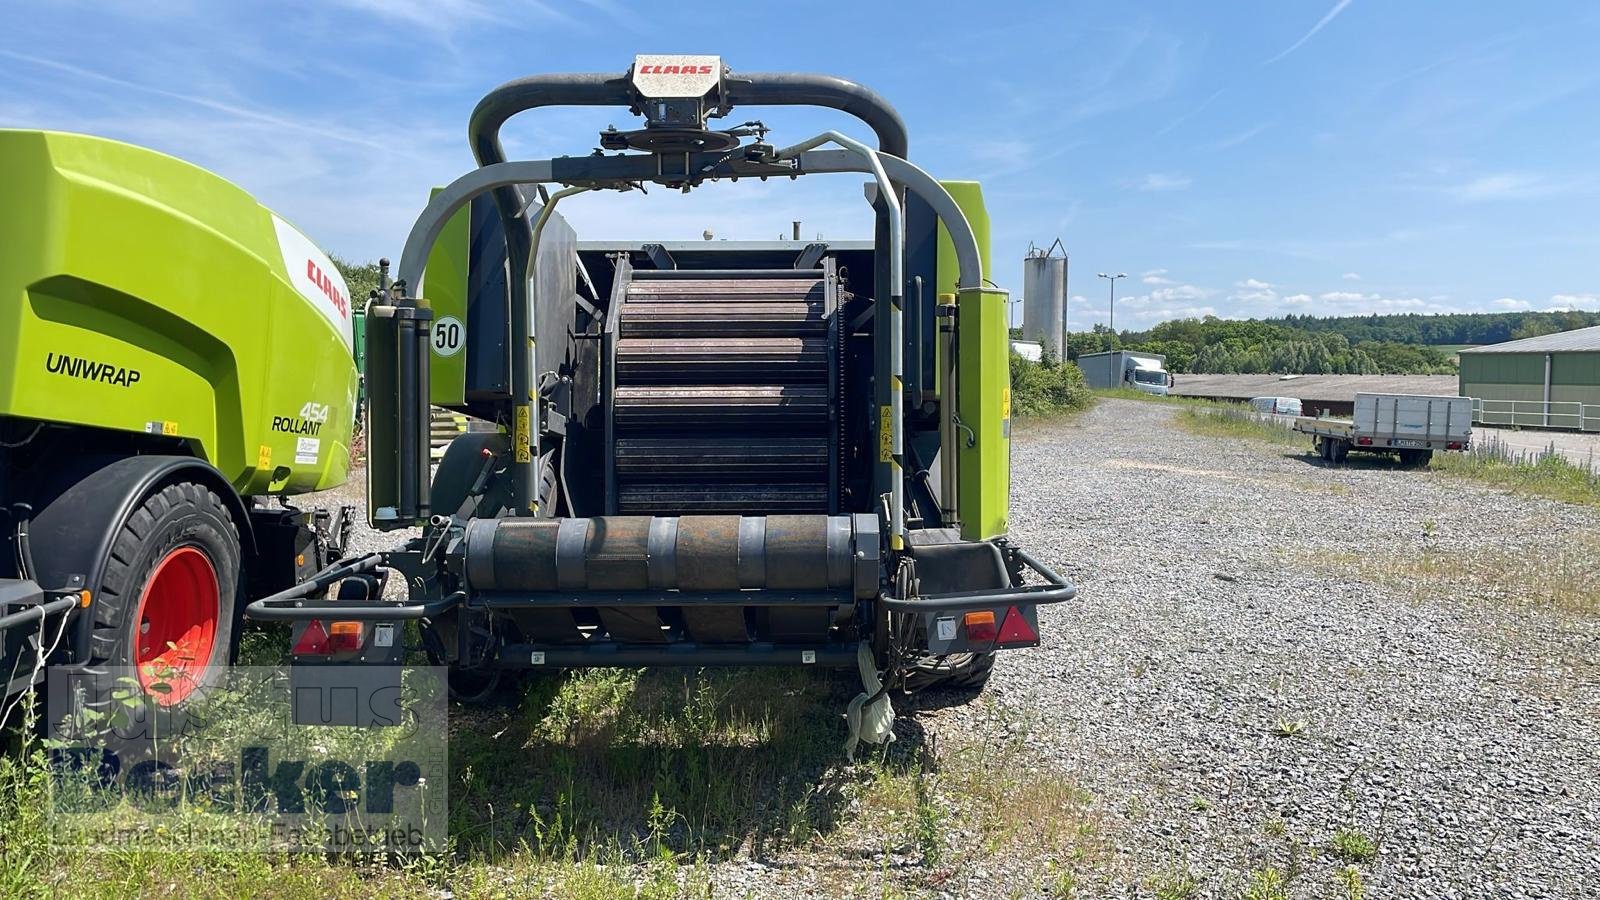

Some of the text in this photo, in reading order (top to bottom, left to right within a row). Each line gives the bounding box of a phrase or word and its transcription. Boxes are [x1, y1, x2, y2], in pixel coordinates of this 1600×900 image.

[640, 65, 712, 75] CLAAS
[307, 259, 347, 320] CLAAS
[436, 323, 459, 349] 50
[46, 352, 141, 387] UNIWRAP
[300, 402, 329, 423] 454
[272, 416, 322, 436] ROLLANT
